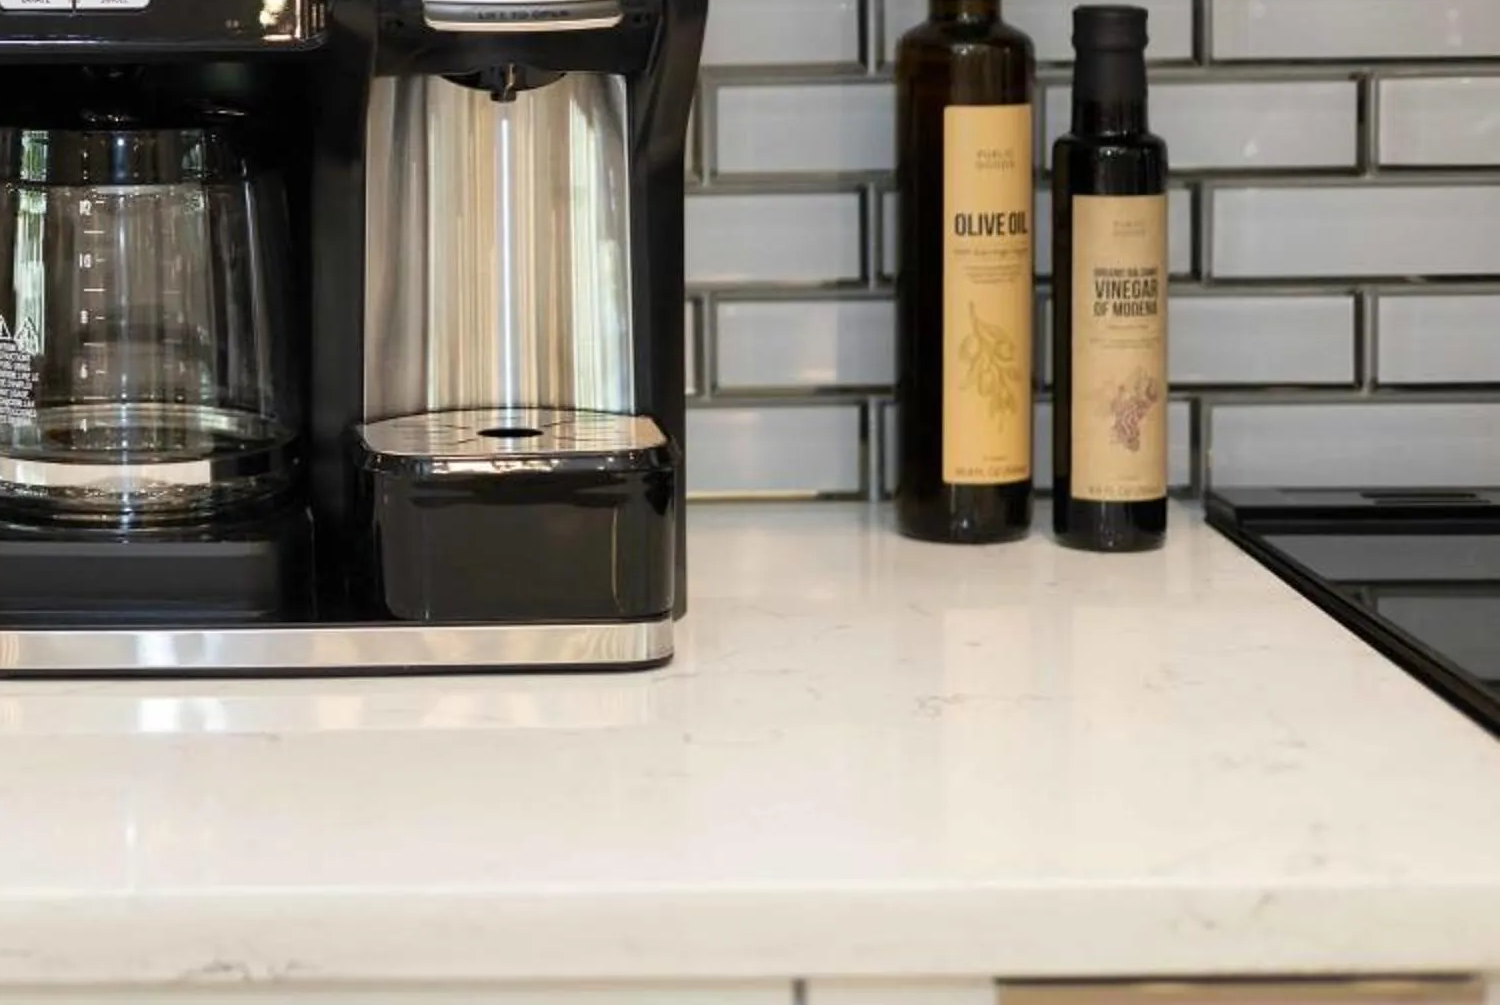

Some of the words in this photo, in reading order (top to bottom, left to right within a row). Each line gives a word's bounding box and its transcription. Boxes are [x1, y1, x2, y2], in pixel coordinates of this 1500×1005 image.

[954, 212, 1005, 236] OLIVE
[1008, 211, 1028, 235] OIL
[1094, 278, 1159, 300] VINEGAR
[1093, 301, 1109, 316] OF
[1112, 300, 1158, 317] MODENA
